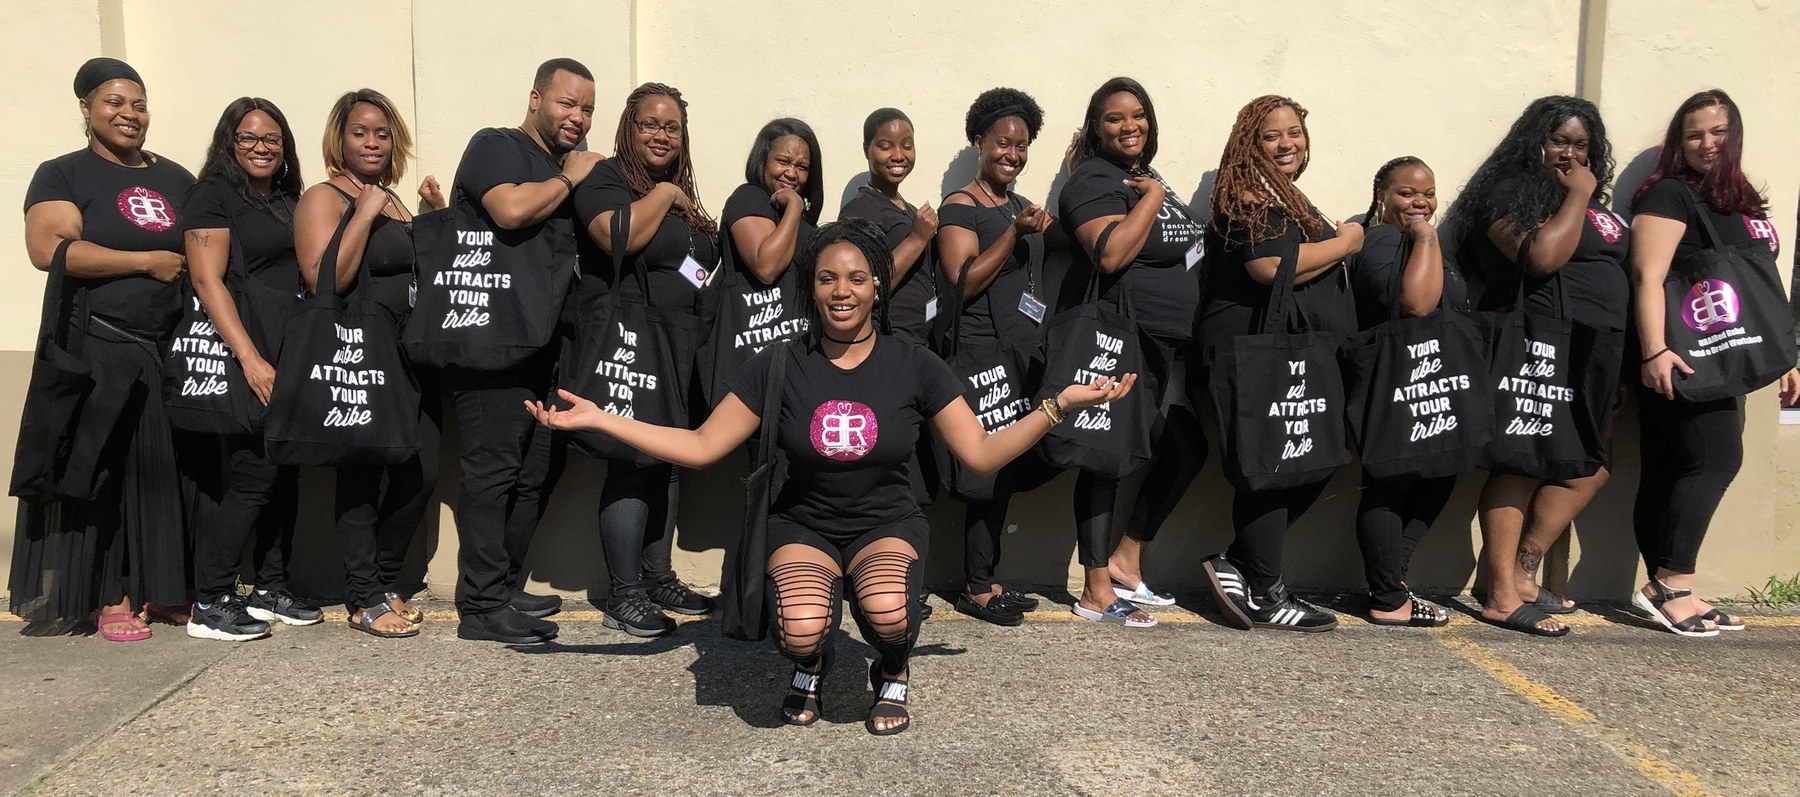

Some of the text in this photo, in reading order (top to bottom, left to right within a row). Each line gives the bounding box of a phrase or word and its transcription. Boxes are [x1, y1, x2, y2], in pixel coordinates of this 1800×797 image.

[456, 229, 494, 246] YOUR
[452, 247, 491, 269] vibe
[433, 270, 511, 289] ATTRACTS
[449, 289, 490, 307] YOUR
[741, 286, 782, 307] YOUR
[441, 308, 490, 330] tribe
[749, 303, 784, 328] vibe
[334, 322, 364, 344] YOUR
[1095, 330, 1124, 354] YOUR
[172, 337, 236, 358] ATTRAC
[332, 345, 364, 365] vibe
[1407, 338, 1440, 359] YOUR
[1524, 338, 1556, 360] YOUR
[186, 356, 226, 375] YOUR
[1089, 352, 1118, 371] vibe
[1410, 357, 1443, 383] vibe
[1519, 358, 1555, 378] vibe
[181, 375, 228, 396] tribe
[310, 364, 385, 386] ATTRACTS
[968, 364, 1008, 389] YOUR
[329, 385, 368, 405] YOUR
[979, 382, 1011, 411] vibe
[1393, 375, 1470, 402] ATTRACTS
[1498, 376, 1574, 402] ATTRACTS
[323, 405, 372, 427] tribe
[976, 397, 1032, 428] TTRACTS
[1409, 396, 1451, 417] YOUR
[1515, 396, 1552, 418] YOUR
[1074, 409, 1112, 431] tribe
[1410, 415, 1458, 442] tribe
[1505, 415, 1553, 437] tribe
[791, 670, 821, 692] NIKE
[878, 681, 908, 701] NIKE
